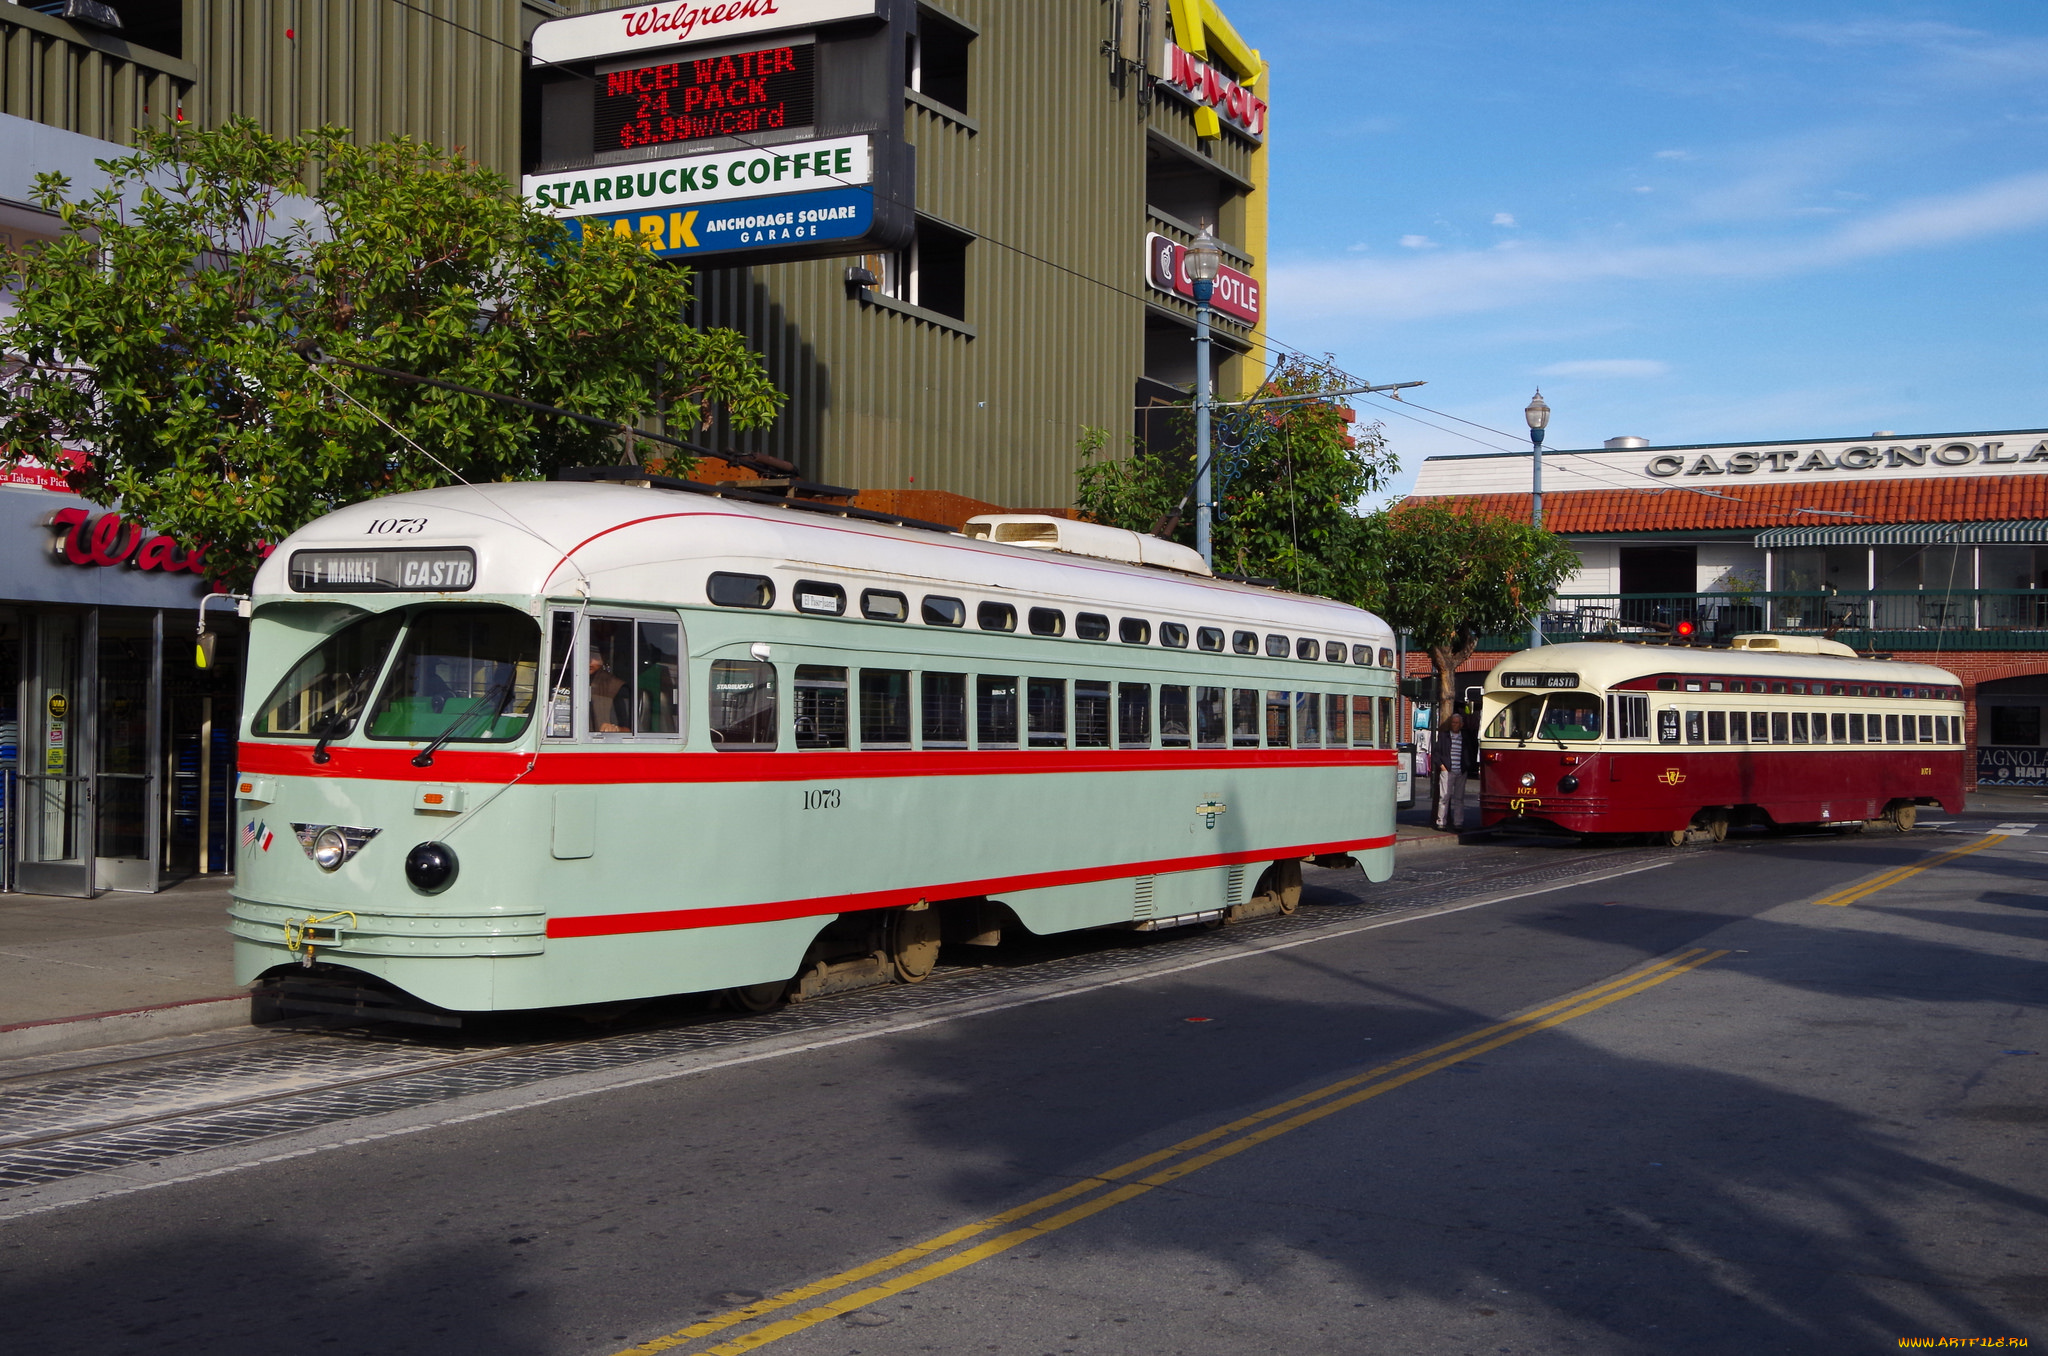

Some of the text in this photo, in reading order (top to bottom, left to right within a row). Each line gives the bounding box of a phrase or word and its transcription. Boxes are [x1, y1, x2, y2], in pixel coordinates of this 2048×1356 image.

[622, 0, 779, 40] Walgreens
[607, 46, 796, 97] NICE! WATER
[636, 77, 768, 119] 24 PACK
[1164, 42, 1267, 135] IN-N-OUT
[534, 147, 853, 210] STARBUCKS COFFEE
[582, 210, 700, 252] ARK
[706, 205, 857, 233] ANCHORAGE SQUARE
[740, 225, 818, 243] GARAGE
[1181, 260, 1258, 313] CPOTLE
[10, 472, 35, 484] Takes
[36, 475, 48, 486] Its
[363, 517, 429, 535] 1073
[313, 558, 474, 587] F MARKET CASTR
[1515, 676, 1538, 686] MARKET
[2015, 766, 2048, 778] HAP
[802, 788, 841, 810] 1073
